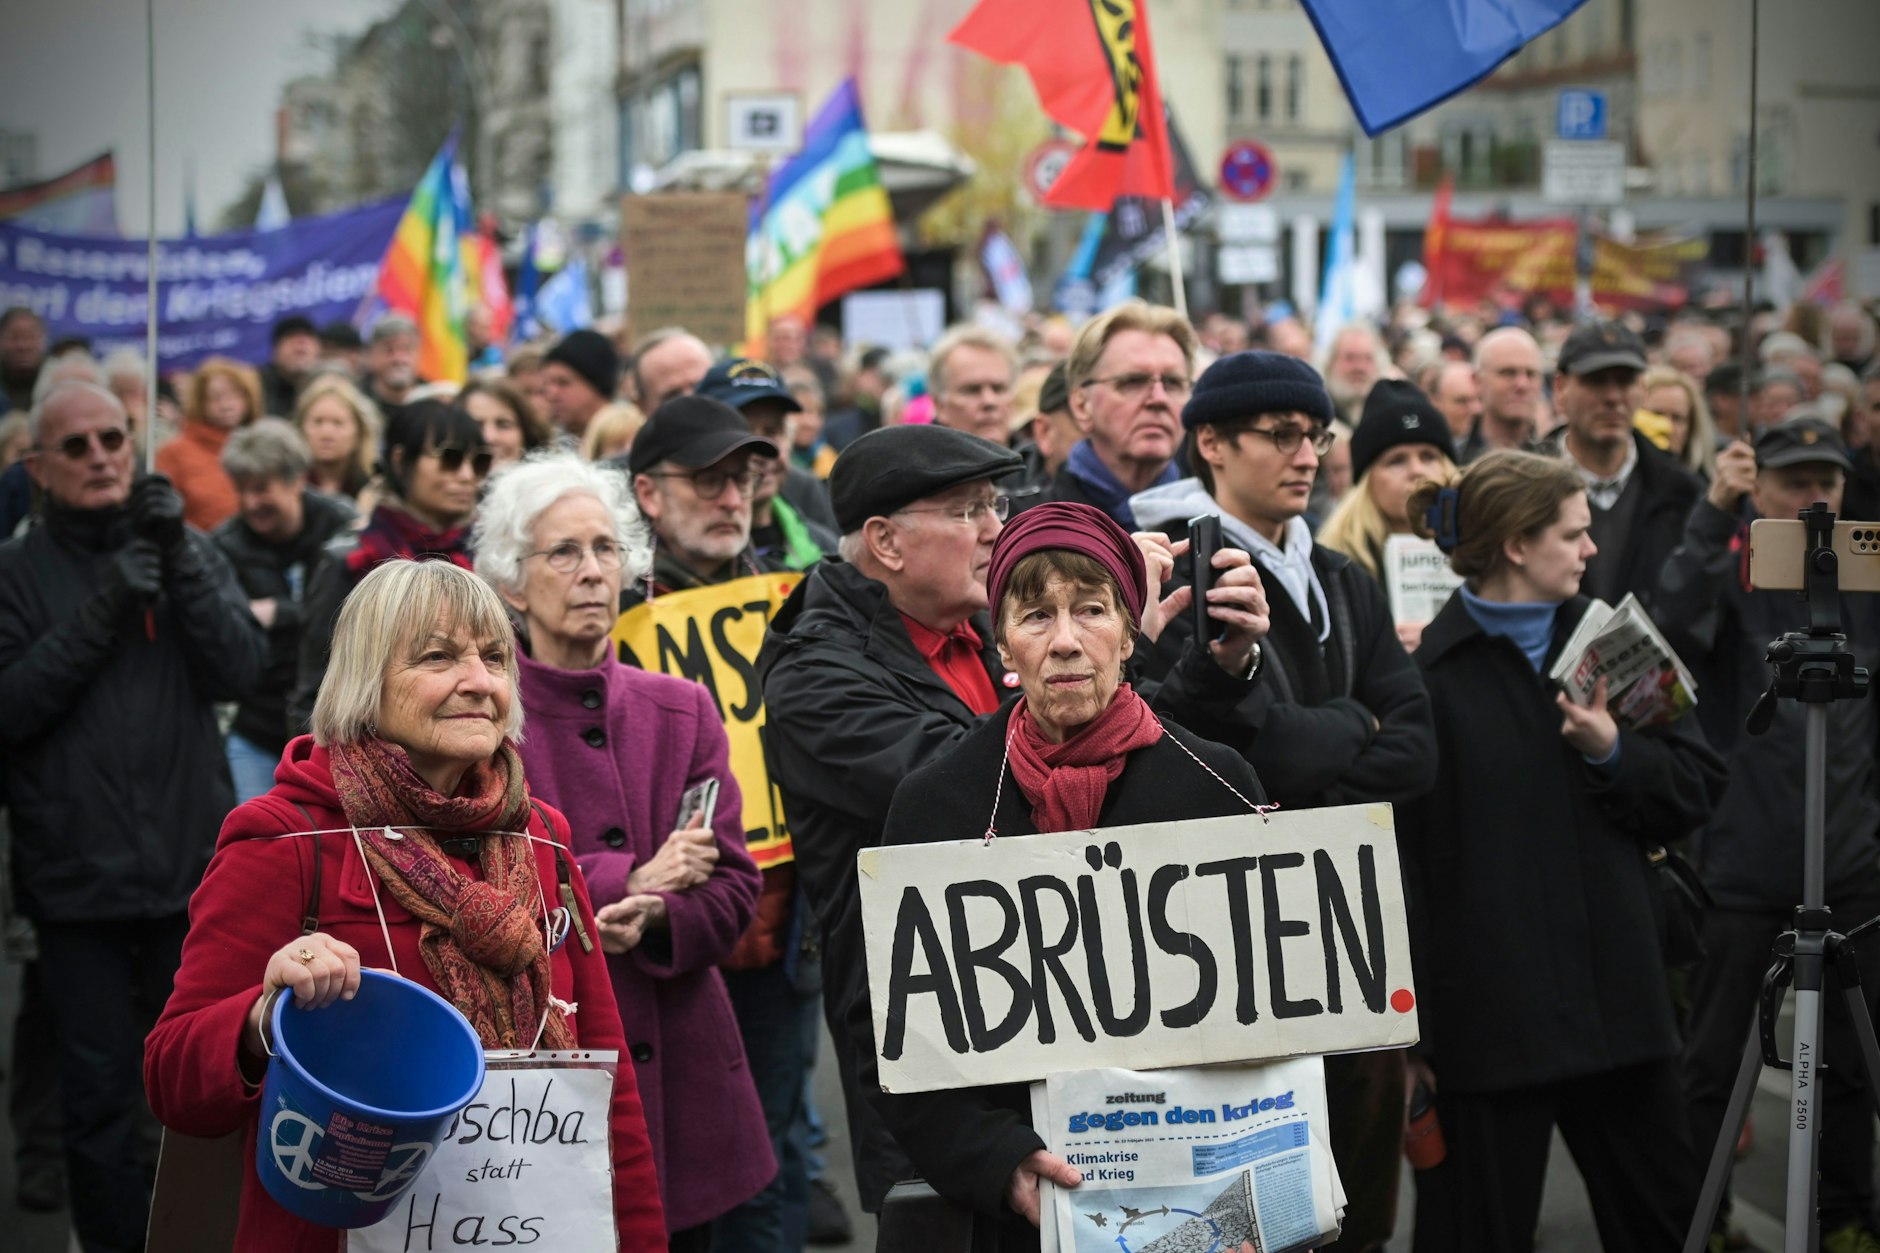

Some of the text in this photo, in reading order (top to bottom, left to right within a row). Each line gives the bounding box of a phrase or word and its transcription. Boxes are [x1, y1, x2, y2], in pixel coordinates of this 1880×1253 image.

[882, 841, 1415, 1060] ABRÜSTEN.
[1105, 1091, 1166, 1105] zeitung
[1796, 1042, 1810, 1130] ALPHA 2500
[1068, 1090, 1294, 1133] gegen den krieg
[465, 1158, 533, 1182] statt
[1067, 1151, 1138, 1166] Klimakrise
[1080, 1168, 1134, 1182] nd Krieg
[404, 1192, 545, 1253] Hass
